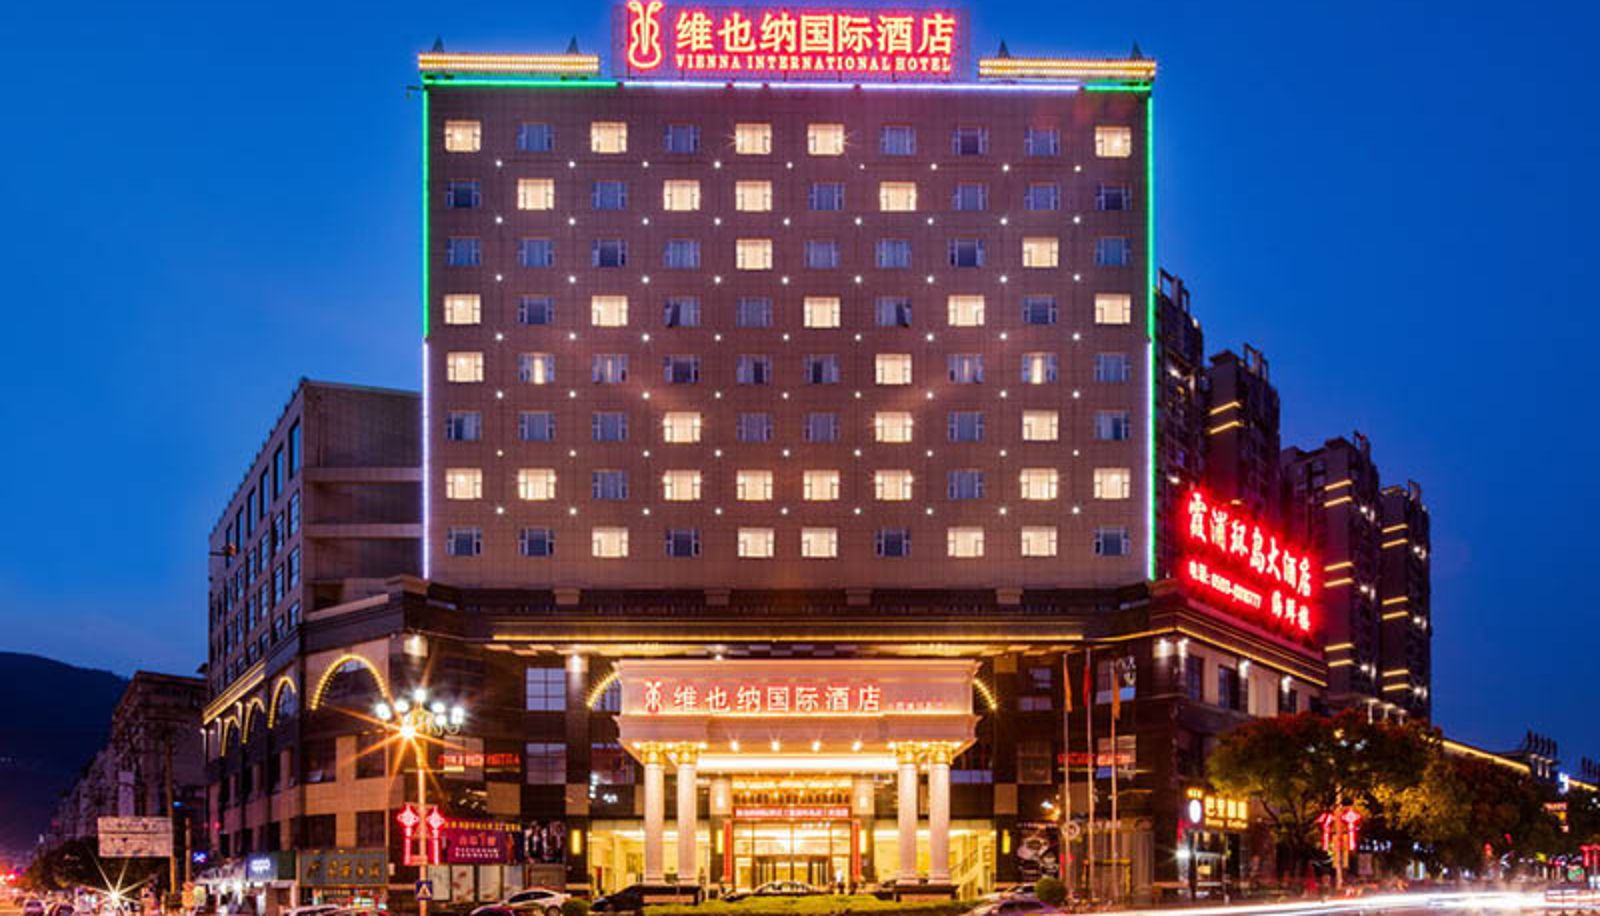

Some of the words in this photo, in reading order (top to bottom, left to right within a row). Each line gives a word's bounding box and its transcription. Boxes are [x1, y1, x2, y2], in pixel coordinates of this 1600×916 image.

[676, 12, 955, 53] 维也纳国际酒店
[676, 54, 741, 70] VIENNA
[749, 55, 890, 71] INTERNATIONAL
[895, 57, 951, 72] HOTEL
[674, 684, 881, 713] 维也纳国际酒店
